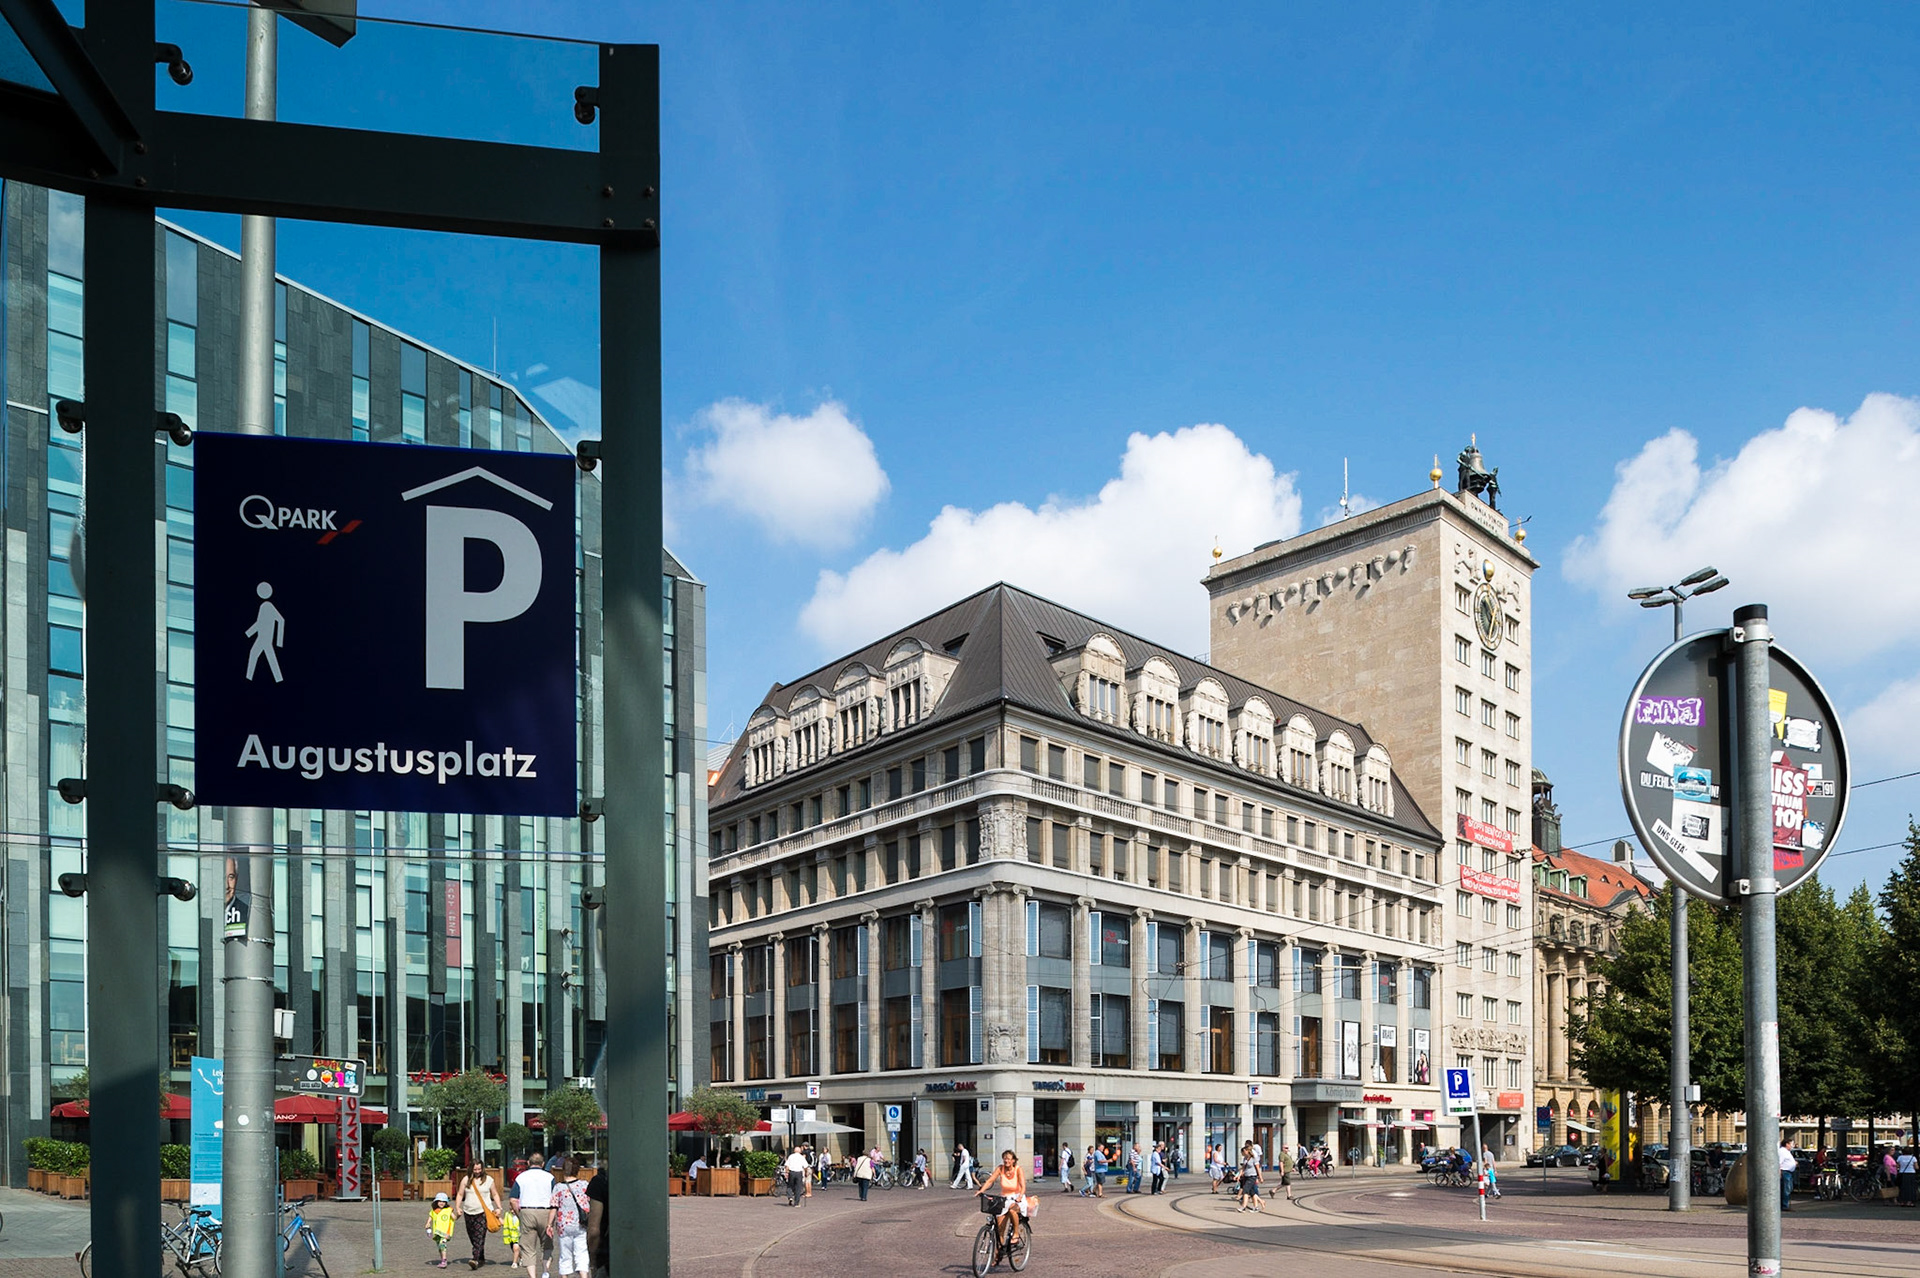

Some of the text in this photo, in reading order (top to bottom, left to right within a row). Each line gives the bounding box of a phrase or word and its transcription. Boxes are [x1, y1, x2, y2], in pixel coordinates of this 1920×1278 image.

[426, 505, 543, 690] P
[237, 734, 537, 785] Augustusplatz
[1771, 767, 1805, 796] ISS
